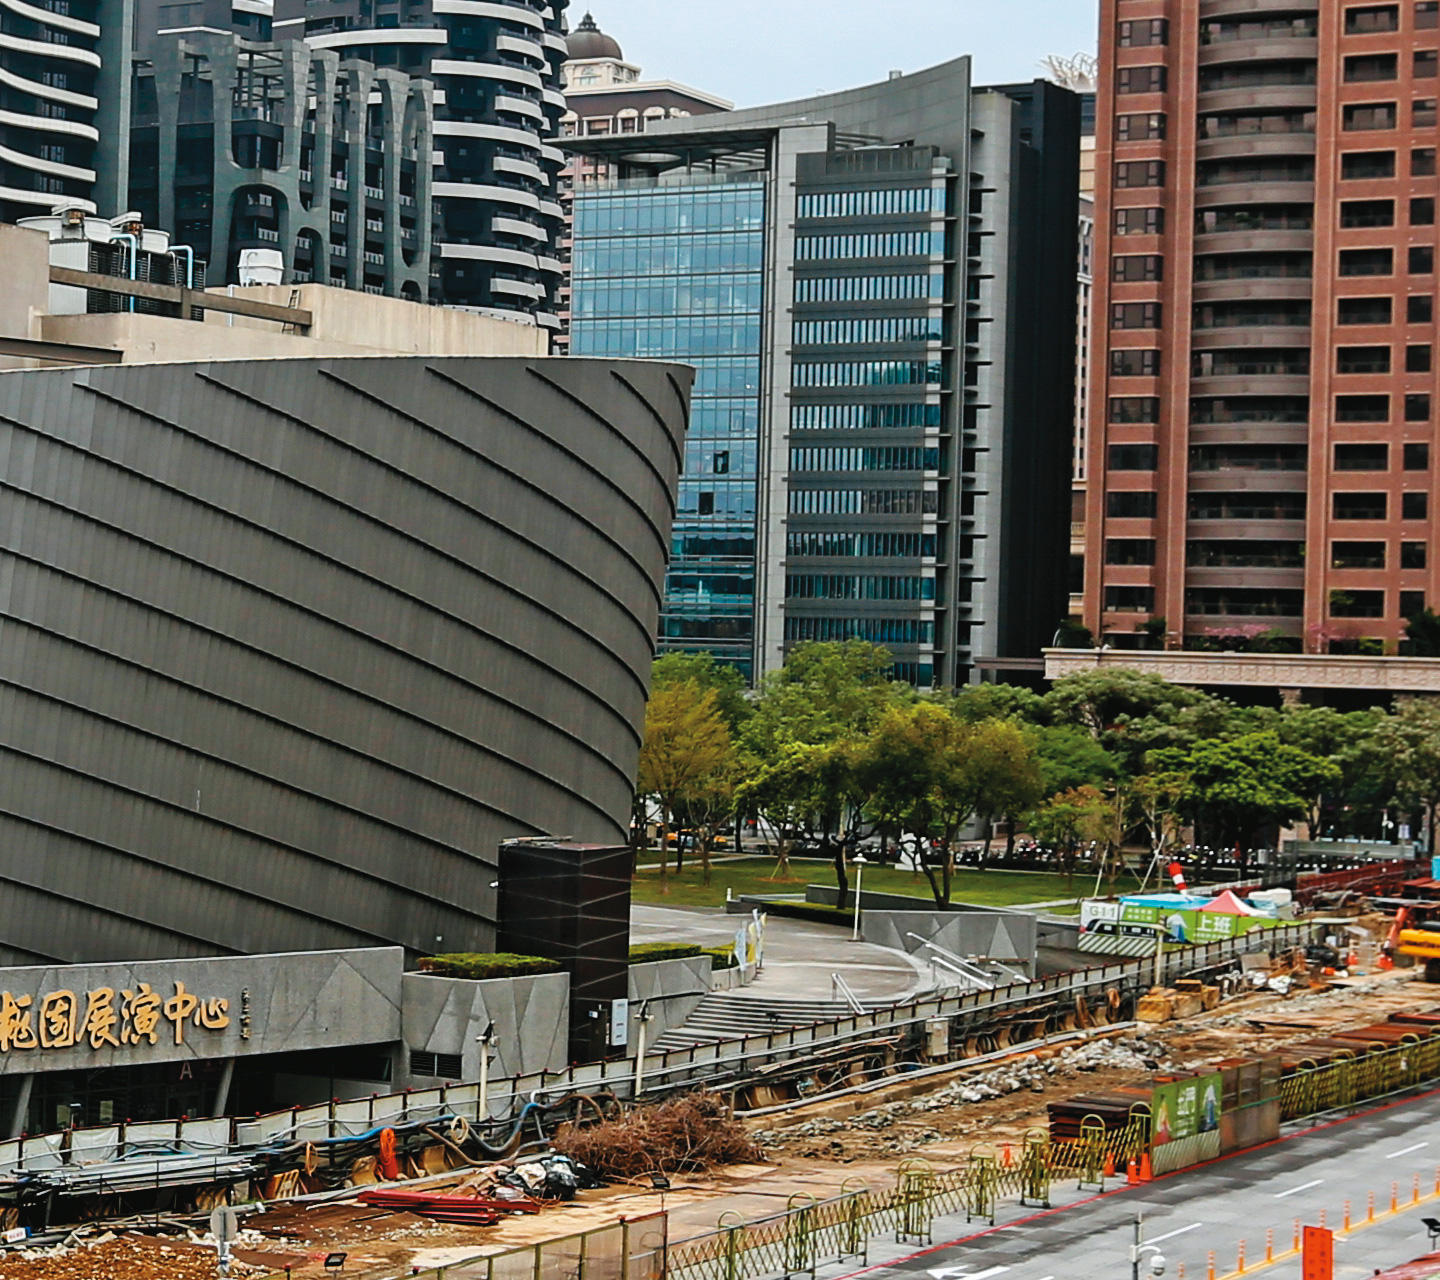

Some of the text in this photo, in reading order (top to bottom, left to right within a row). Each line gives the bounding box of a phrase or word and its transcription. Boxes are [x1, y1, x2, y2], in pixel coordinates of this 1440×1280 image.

[1089, 904, 1116, 919] G11
[1199, 914, 1232, 933] 上班
[180, 1061, 193, 1081] A
